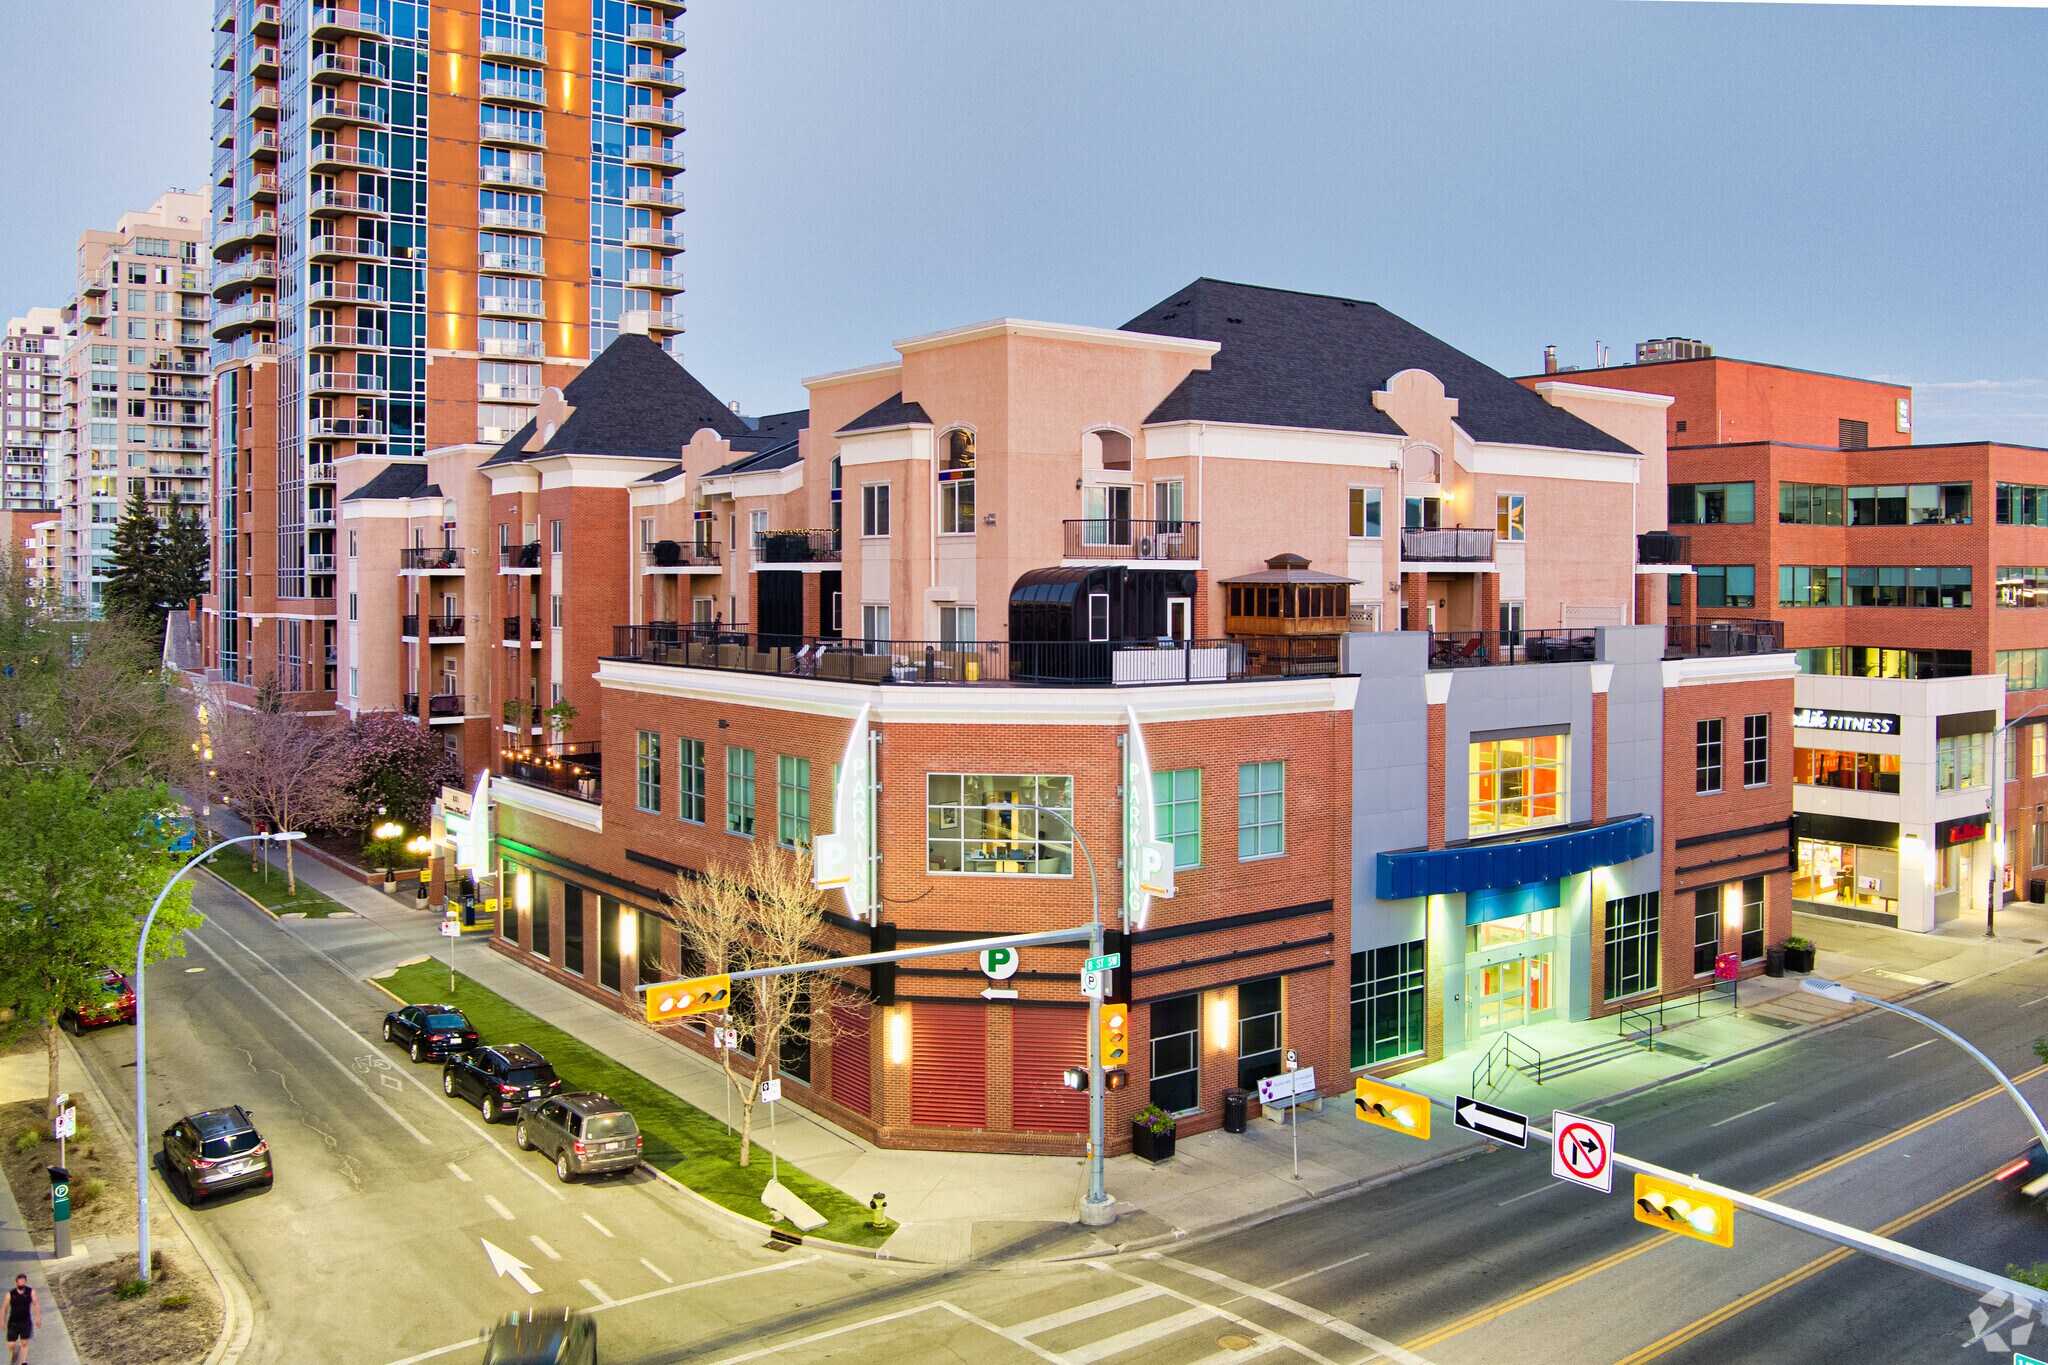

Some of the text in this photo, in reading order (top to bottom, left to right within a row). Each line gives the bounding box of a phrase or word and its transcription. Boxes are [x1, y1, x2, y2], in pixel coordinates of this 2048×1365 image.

[1829, 716, 1891, 733] FITNESS
[853, 758, 867, 903] PARKING
[1129, 763, 1140, 911] PARKING
[822, 843, 848, 877] P
[1142, 847, 1162, 881] P
[988, 948, 1010, 972] P
[1088, 955, 1118, 971] 8 ST SW
[1089, 976, 1094, 985] P
[59, 1187, 65, 1195] P
